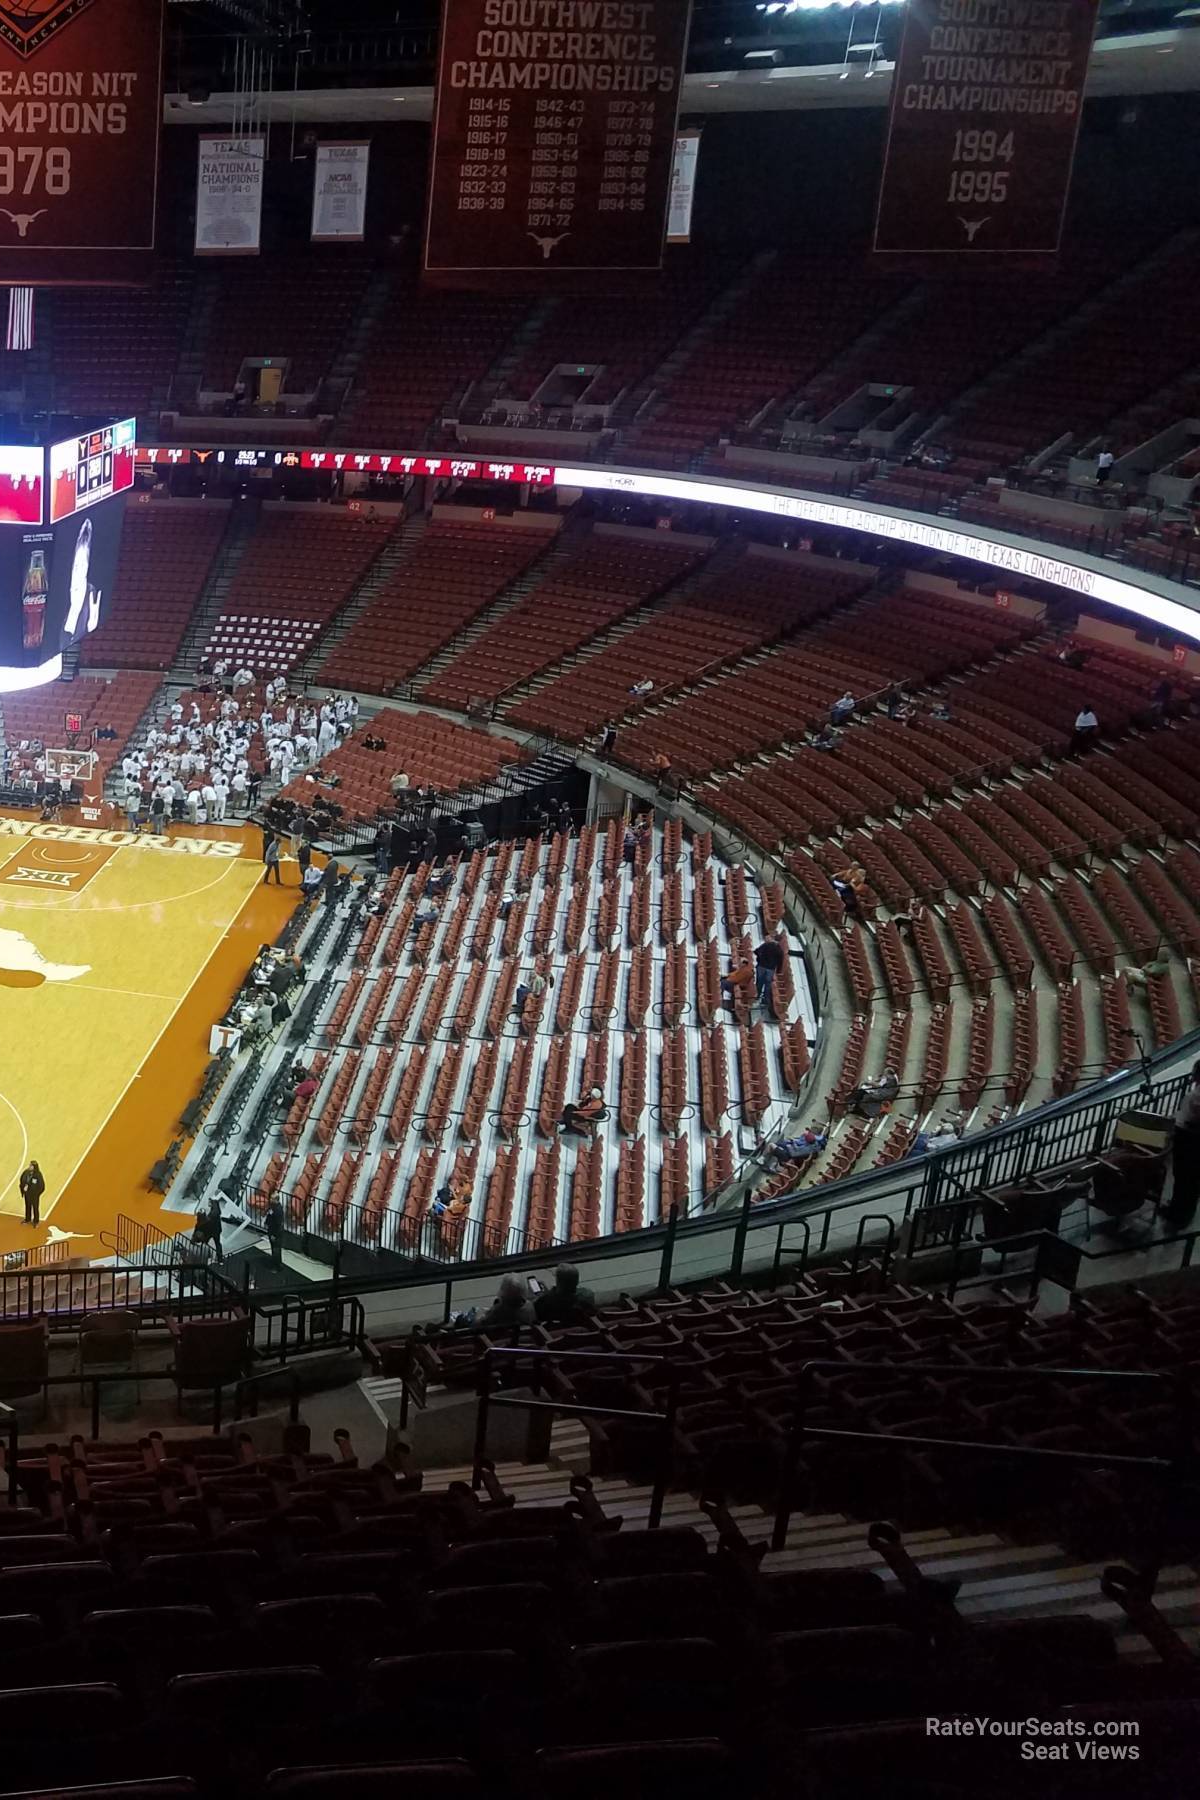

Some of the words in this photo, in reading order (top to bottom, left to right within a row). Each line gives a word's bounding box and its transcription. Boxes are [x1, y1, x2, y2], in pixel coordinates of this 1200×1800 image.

[484, 0, 654, 29] SOUTHWEST
[476, 31, 656, 60] CONFERENCE
[930, 26, 1072, 56] CONFERENCE
[450, 61, 675, 92] CHAMPIONSHIPS
[921, 55, 1073, 85] TOURNAMENT
[92, 72, 137, 97] NIT
[469, 98, 511, 111] 1914-15
[903, 84, 1078, 114] CHAMPIONSHIPS
[468, 115, 509, 128] 1915-16
[467, 131, 507, 145] 1916-17
[952, 129, 1015, 163] 1994
[202, 162, 260, 173] NATIONAL
[202, 174, 260, 185] CHAMPIONS
[947, 170, 1010, 202] 1995
[527, 214, 571, 227] 1971-72
[217, 451, 225, 463] 0
[274, 452, 282, 464] 0
[349, 502, 360, 511] 42
[483, 511, 494, 520] 41
[773, 496, 792, 515] THE
[797, 500, 841, 524] OFFICIAL
[846, 510, 897, 536] FLAGSHIP
[900, 521, 943, 549] STATION
[946, 533, 961, 554] OF
[963, 537, 982, 560] THE
[986, 544, 1022, 570] TEXAS
[1024, 554, 1096, 593] LONGHORNS!
[1174, 649, 1185, 661] 37
